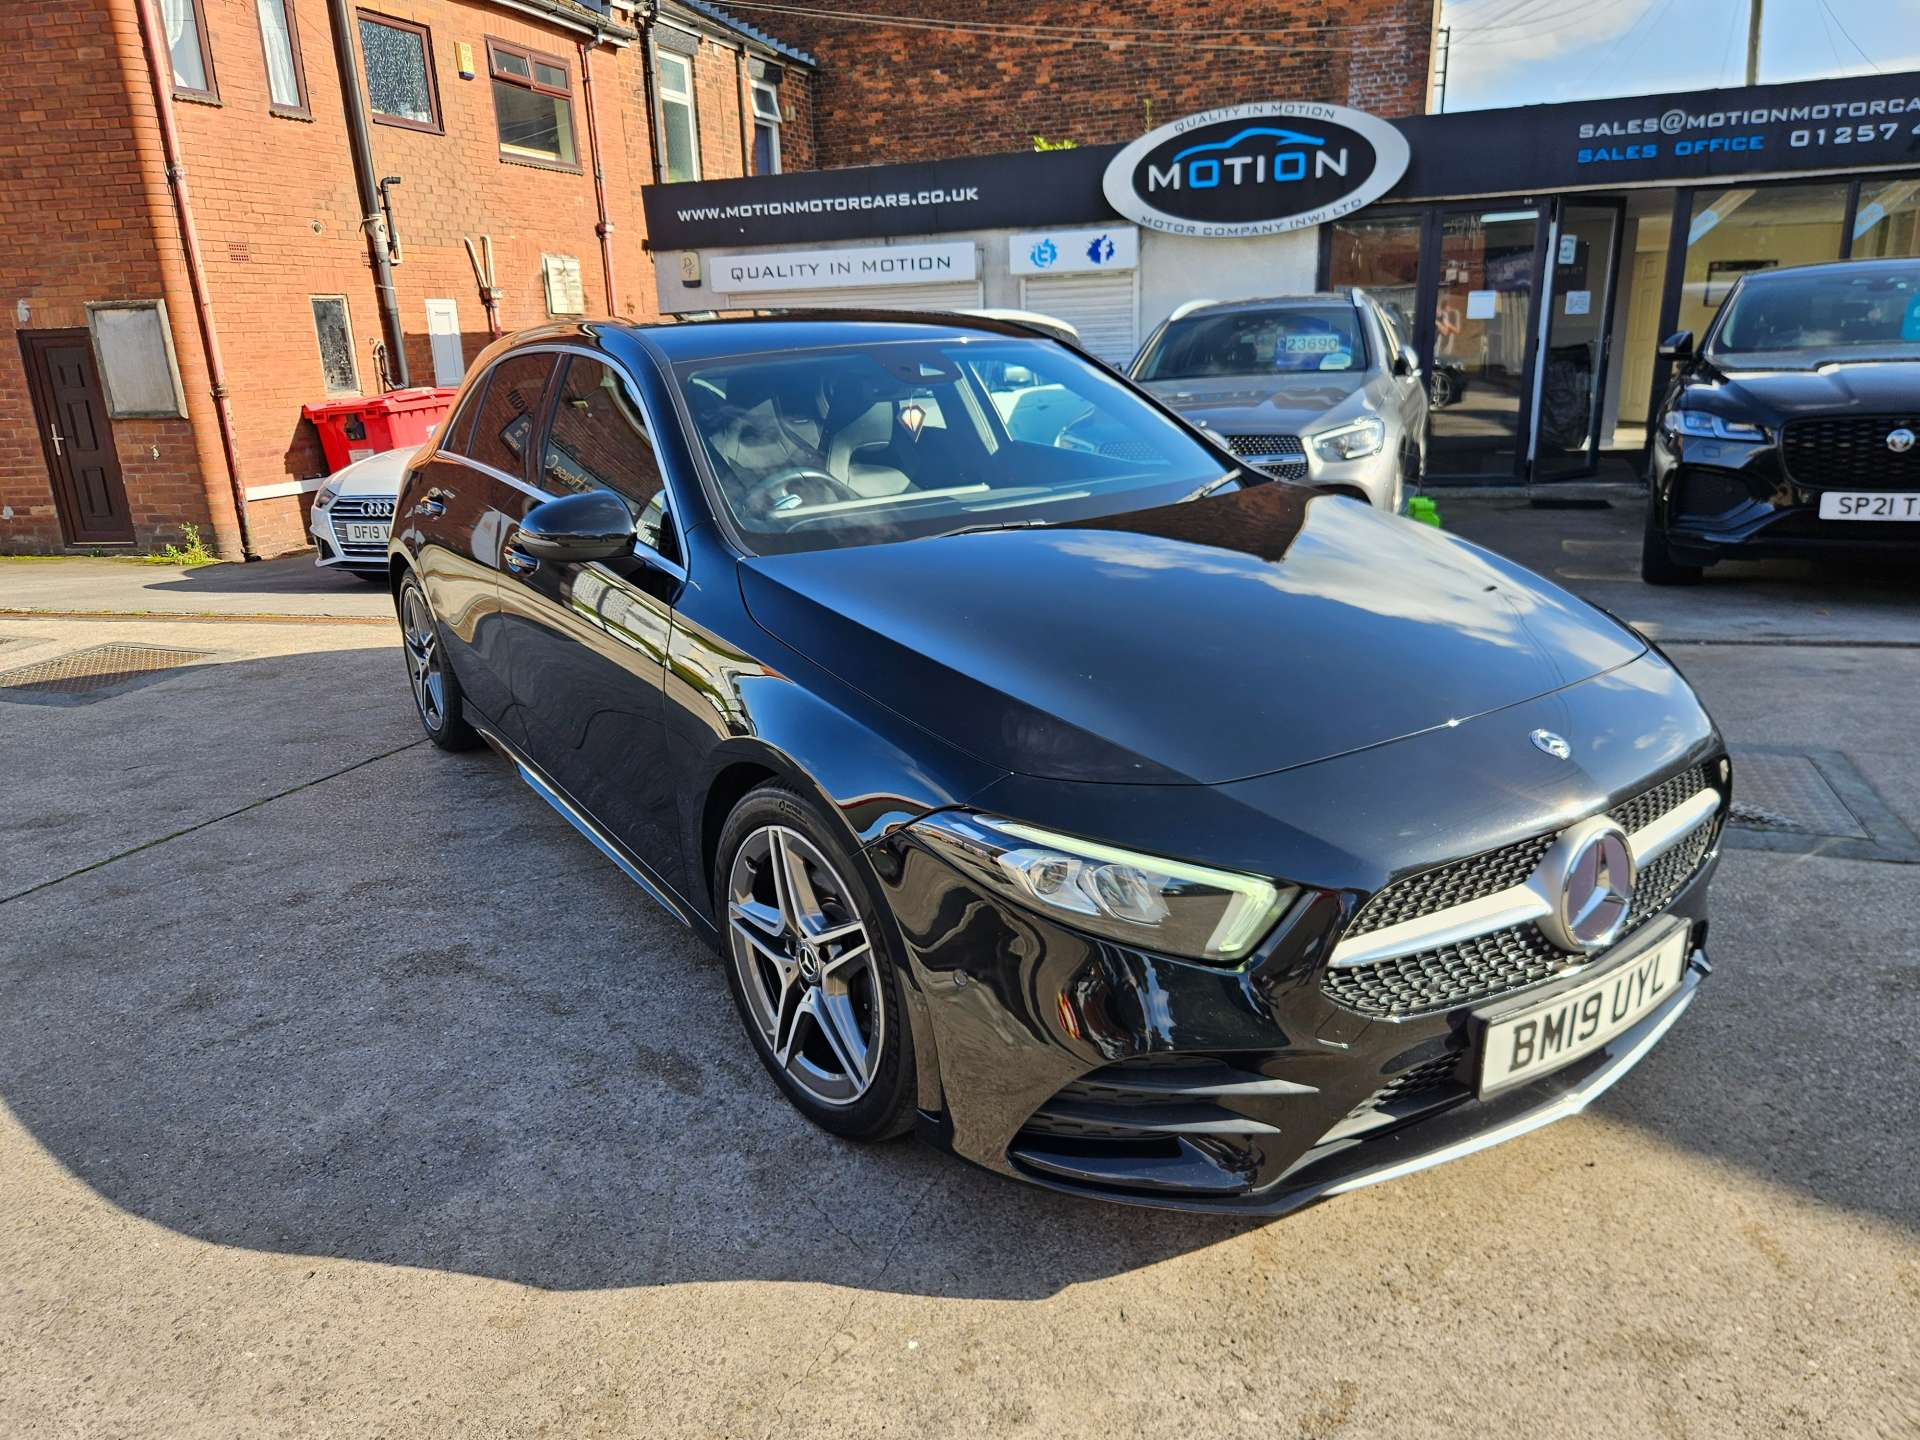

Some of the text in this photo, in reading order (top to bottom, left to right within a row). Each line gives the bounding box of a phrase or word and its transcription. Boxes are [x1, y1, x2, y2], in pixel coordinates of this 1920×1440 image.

[1174, 103, 1336, 132] QUALITY IN MOTION
[1577, 144, 1657, 163] SALES
[1674, 136, 1765, 156] OFFICE
[1790, 123, 1898, 147] 01257
[1148, 148, 1348, 192] MOTION
[677, 188, 979, 222] WWW.MOTIONMOTORCARS.CO.UK
[1141, 215, 1196, 235] MOTOR
[1202, 222, 1283, 236] COMPANY
[1333, 199, 1361, 216] LTD
[731, 256, 951, 282] QUALITY IN MOTION
[1839, 497, 1920, 516] SP21 T
[353, 525, 390, 539] DF19 V
[1509, 954, 1665, 1072] BM19 UYL
